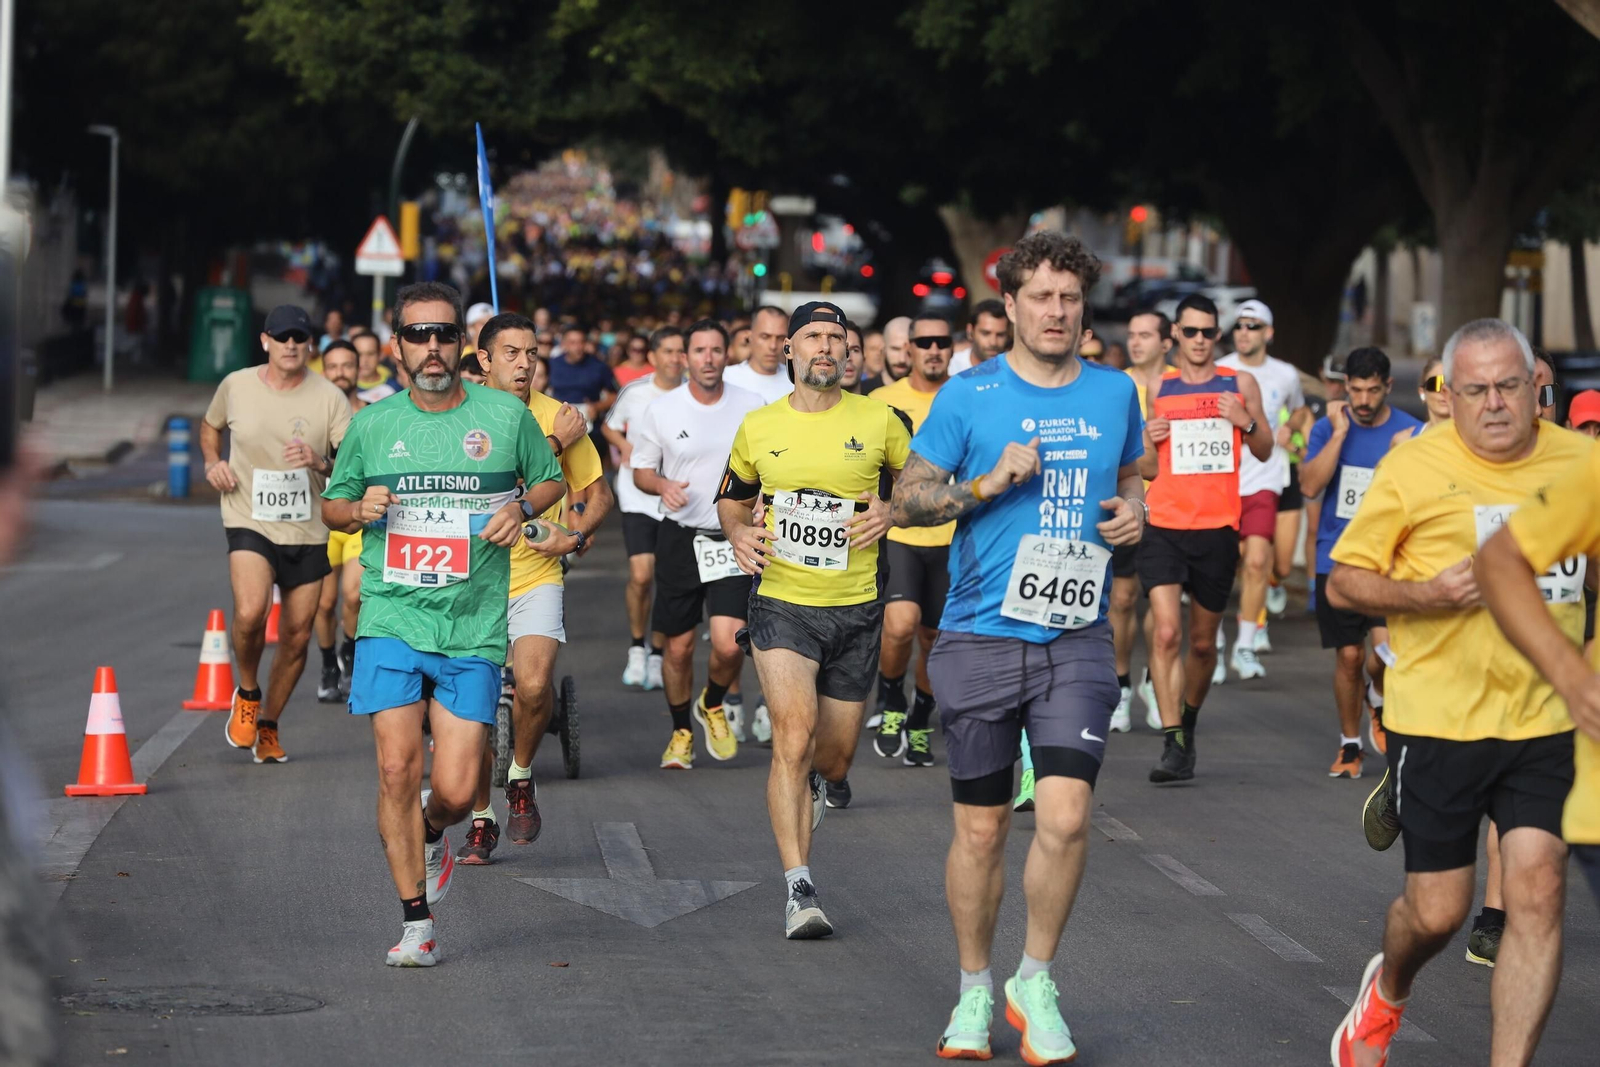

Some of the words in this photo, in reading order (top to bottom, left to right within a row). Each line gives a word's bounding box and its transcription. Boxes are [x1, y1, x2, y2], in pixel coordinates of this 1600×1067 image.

[1038, 418, 1075, 427] ZURICH
[1044, 451, 1065, 461] 21K
[1177, 441, 1231, 457] 11269
[396, 475, 480, 491] ATLETISMO
[1042, 468, 1088, 498] RUN
[257, 490, 307, 506] 10871
[401, 496, 491, 510] RREMOLINOS
[396, 509, 419, 521] 45
[1039, 499, 1084, 528] AND
[778, 518, 847, 548] 10899
[400, 543, 453, 572] 122
[1033, 542, 1061, 557] 45
[1019, 573, 1096, 608] 6466
